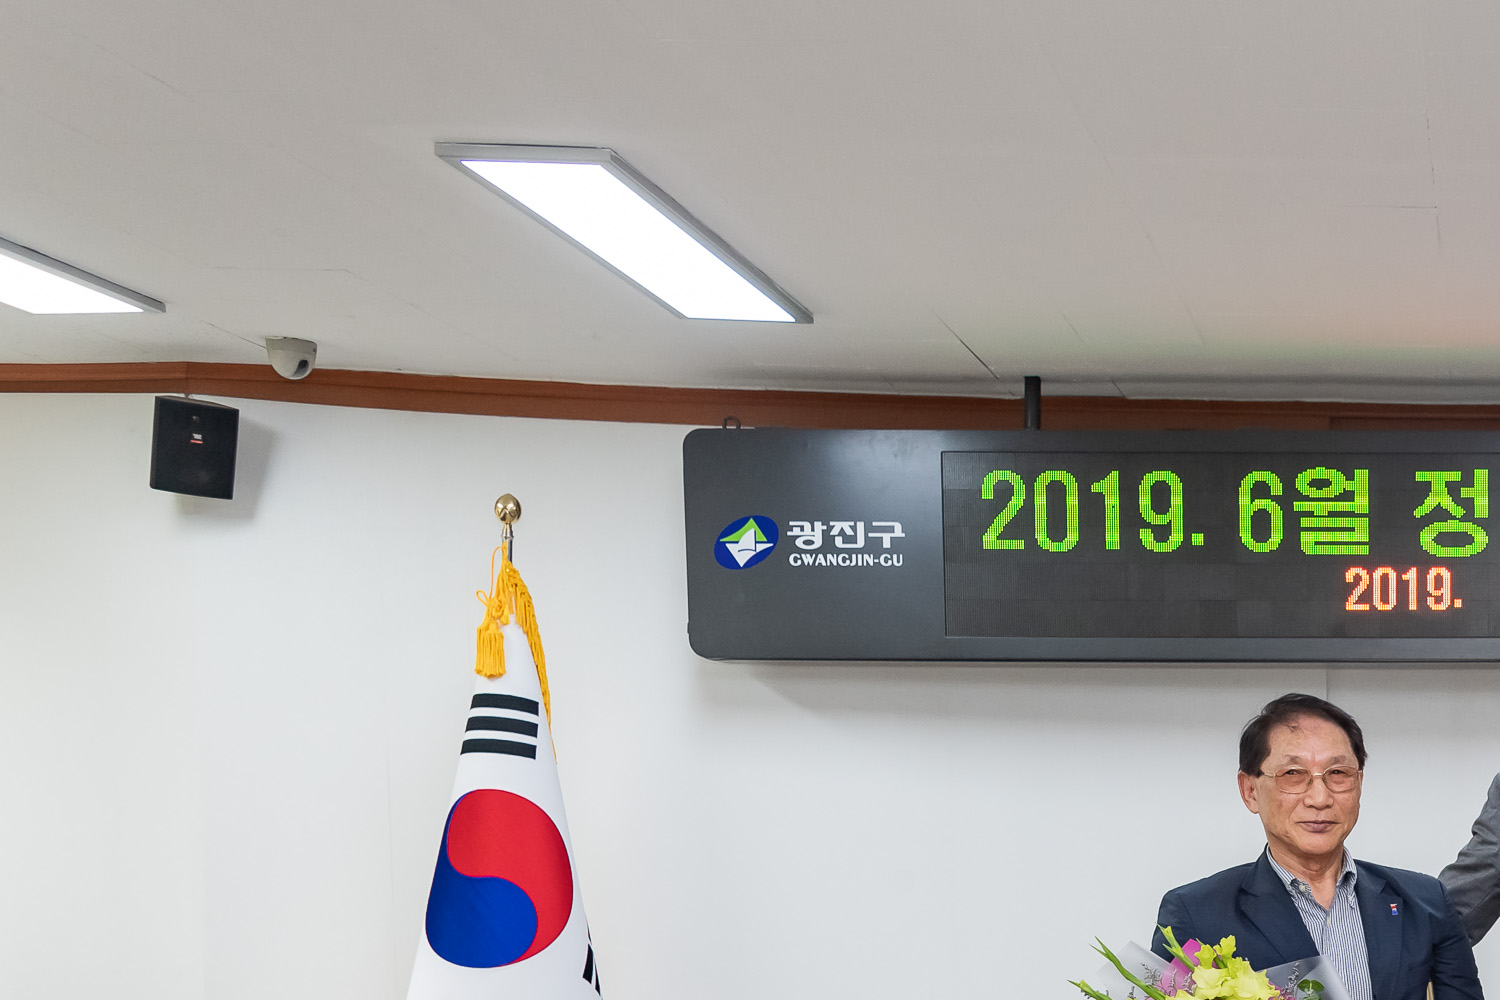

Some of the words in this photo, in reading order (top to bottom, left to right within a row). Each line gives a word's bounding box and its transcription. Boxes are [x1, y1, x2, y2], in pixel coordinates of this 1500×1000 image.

[981, 469, 1204, 553] 2019.
[1238, 466, 1370, 556] 6월
[786, 520, 906, 550] 광진구
[788, 553, 903, 567] GWANGJIN-GU
[1345, 566, 1463, 611] 2019.
